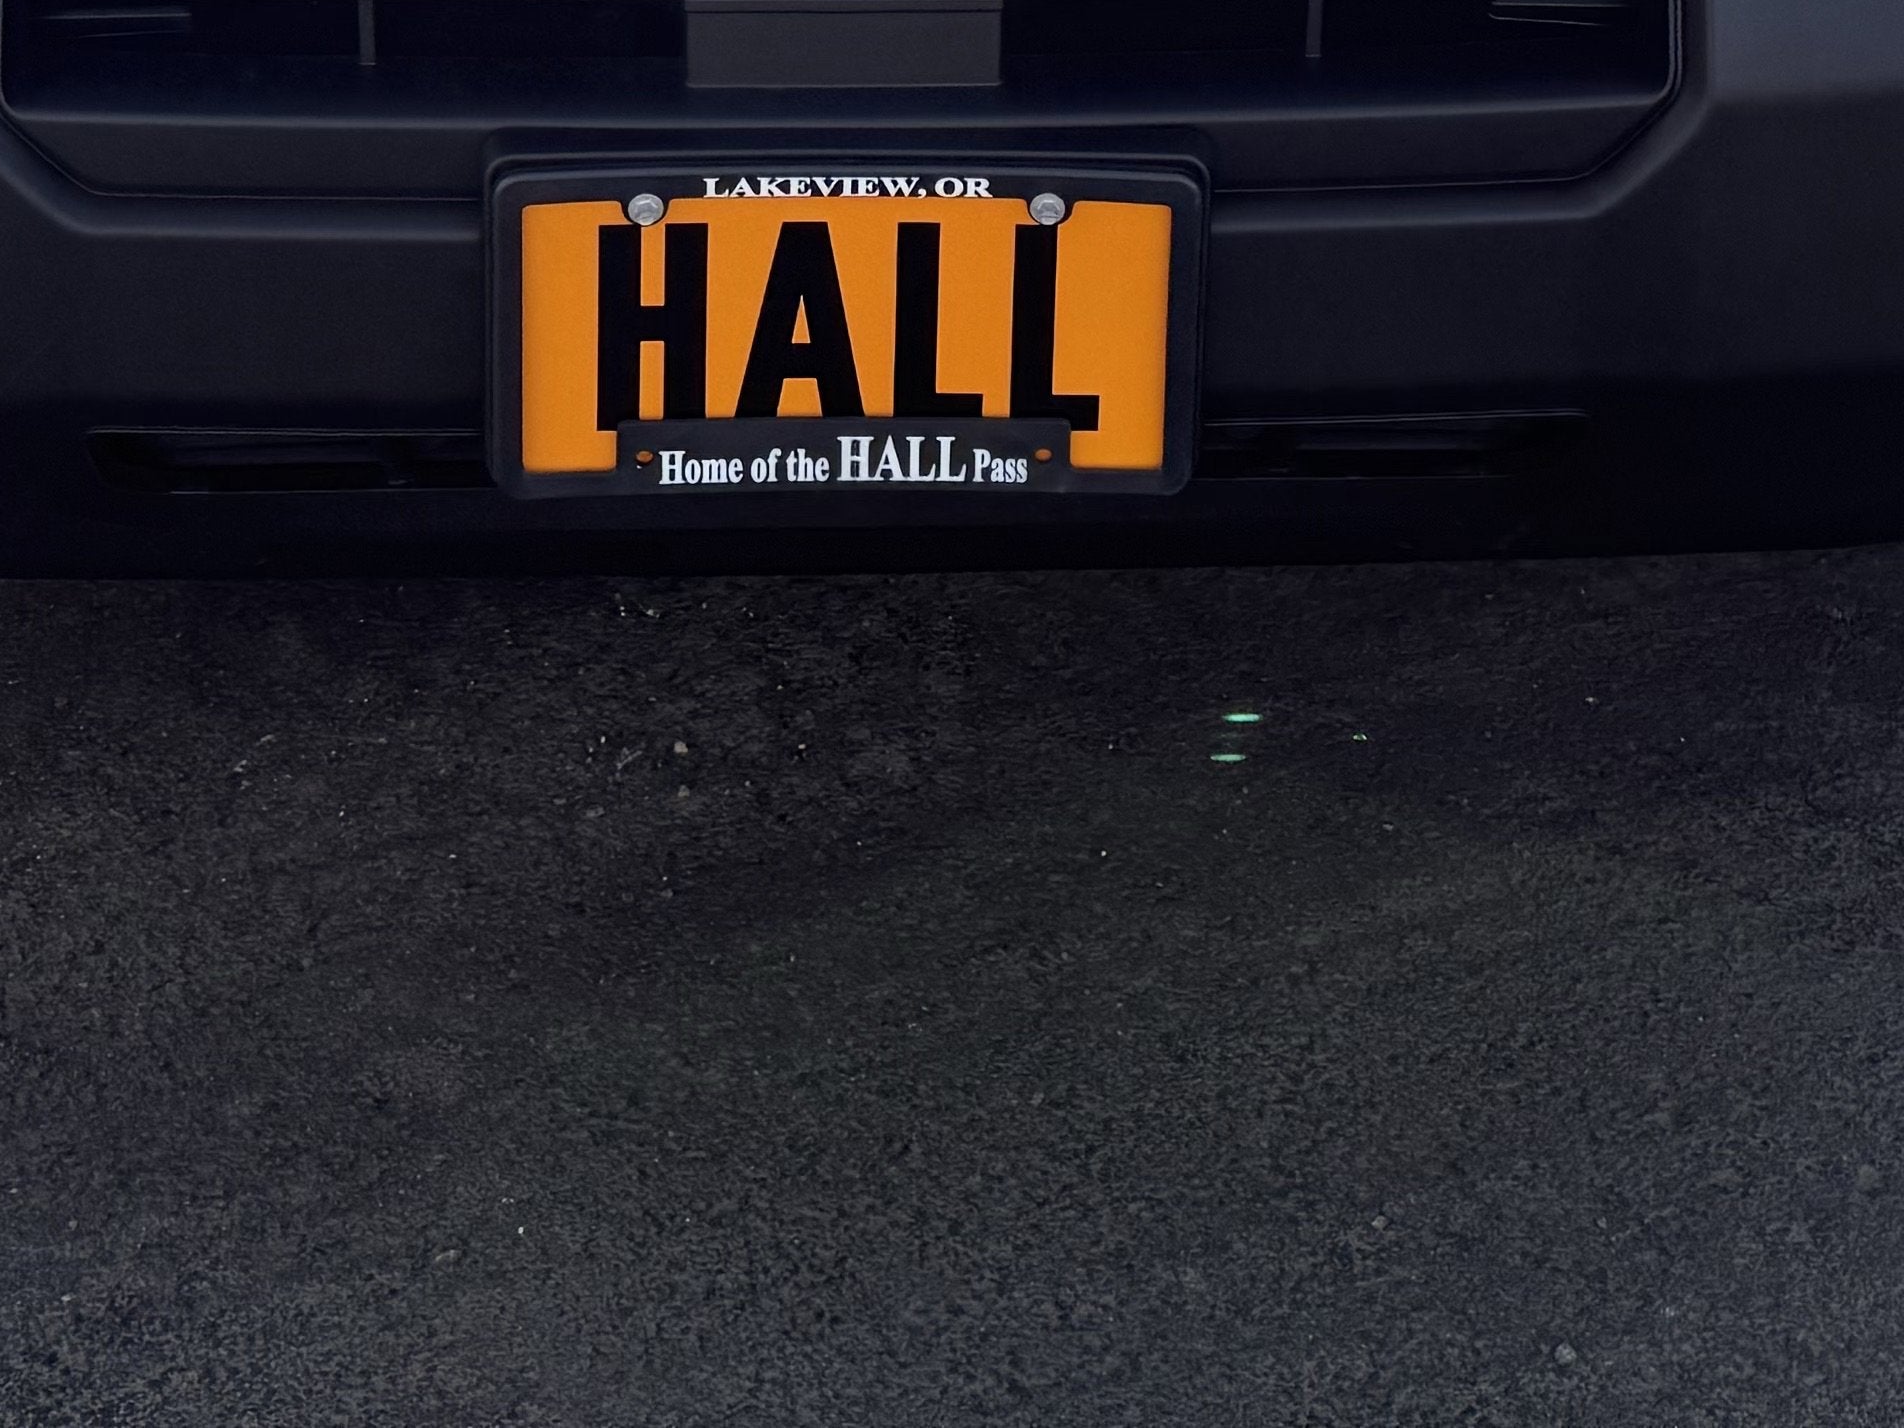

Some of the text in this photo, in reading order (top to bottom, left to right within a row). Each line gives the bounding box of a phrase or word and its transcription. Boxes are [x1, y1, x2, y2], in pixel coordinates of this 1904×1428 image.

[702, 176, 994, 199] LAKEVIEW, OR
[596, 221, 1101, 432] HALL
[658, 434, 1028, 485] Home of the HALL Pass
